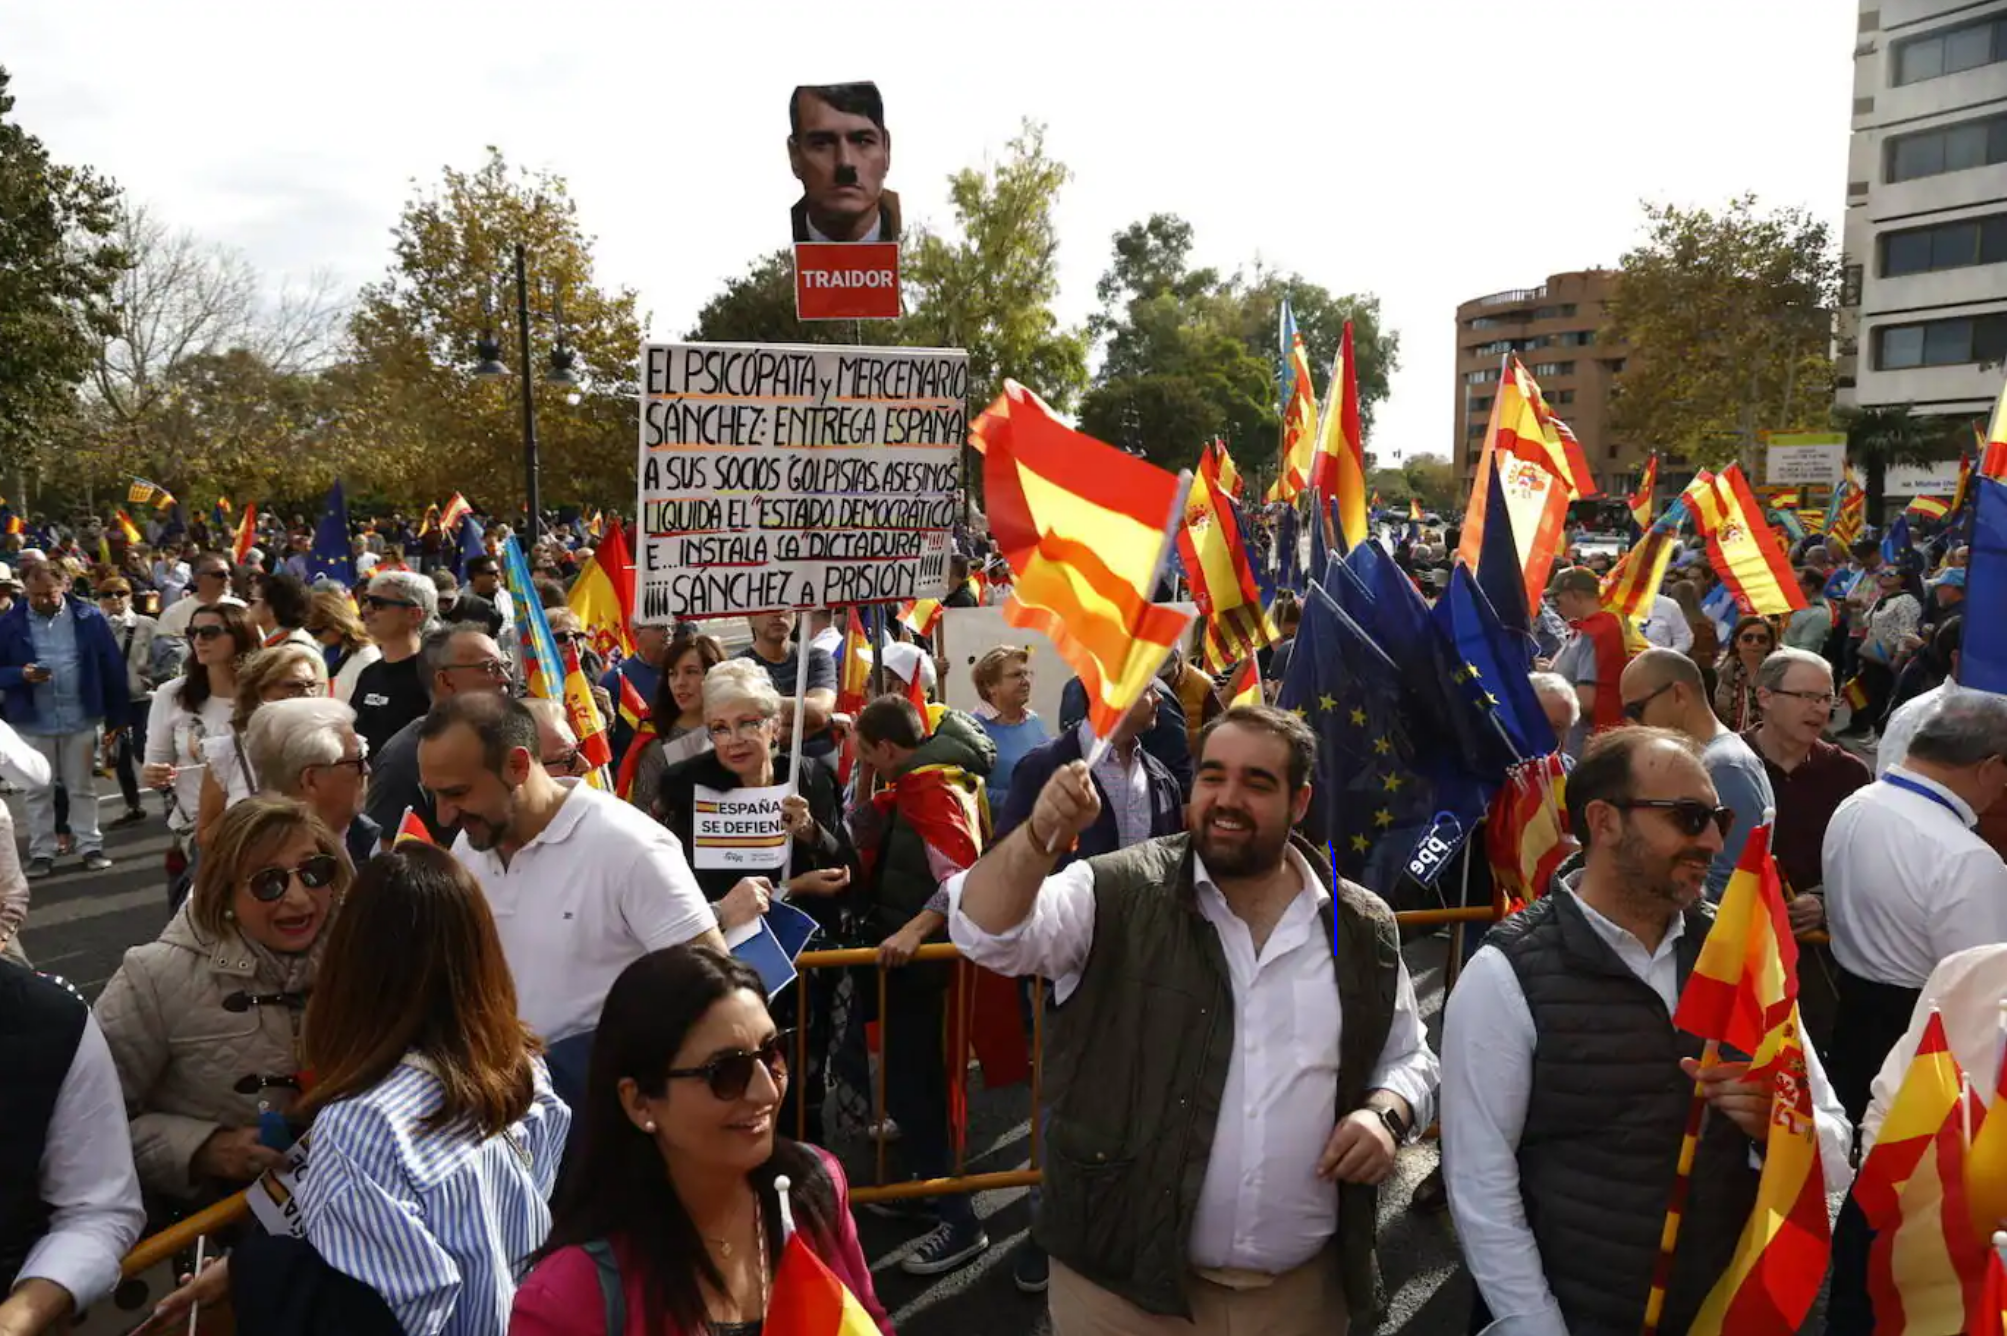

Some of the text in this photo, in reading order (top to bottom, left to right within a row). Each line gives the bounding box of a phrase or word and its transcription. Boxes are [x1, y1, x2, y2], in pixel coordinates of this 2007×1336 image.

[801, 270, 893, 288] TRAIDOR
[648, 349, 677, 395] EL
[685, 349, 816, 397] PSICÓPATA
[837, 356, 968, 400] MERCENARIO
[646, 397, 963, 448] SÁNCHEZ: ENTREGA ESPAÑA
[644, 456, 659, 490] A
[667, 456, 706, 491] SUS
[713, 455, 780, 491] SOCIOS
[645, 499, 722, 534] LIQUIDA
[728, 499, 751, 528] EL
[801, 581, 814, 604] A
[719, 799, 781, 815] ESPAÑA
[701, 820, 784, 834] SE DEFIEN
